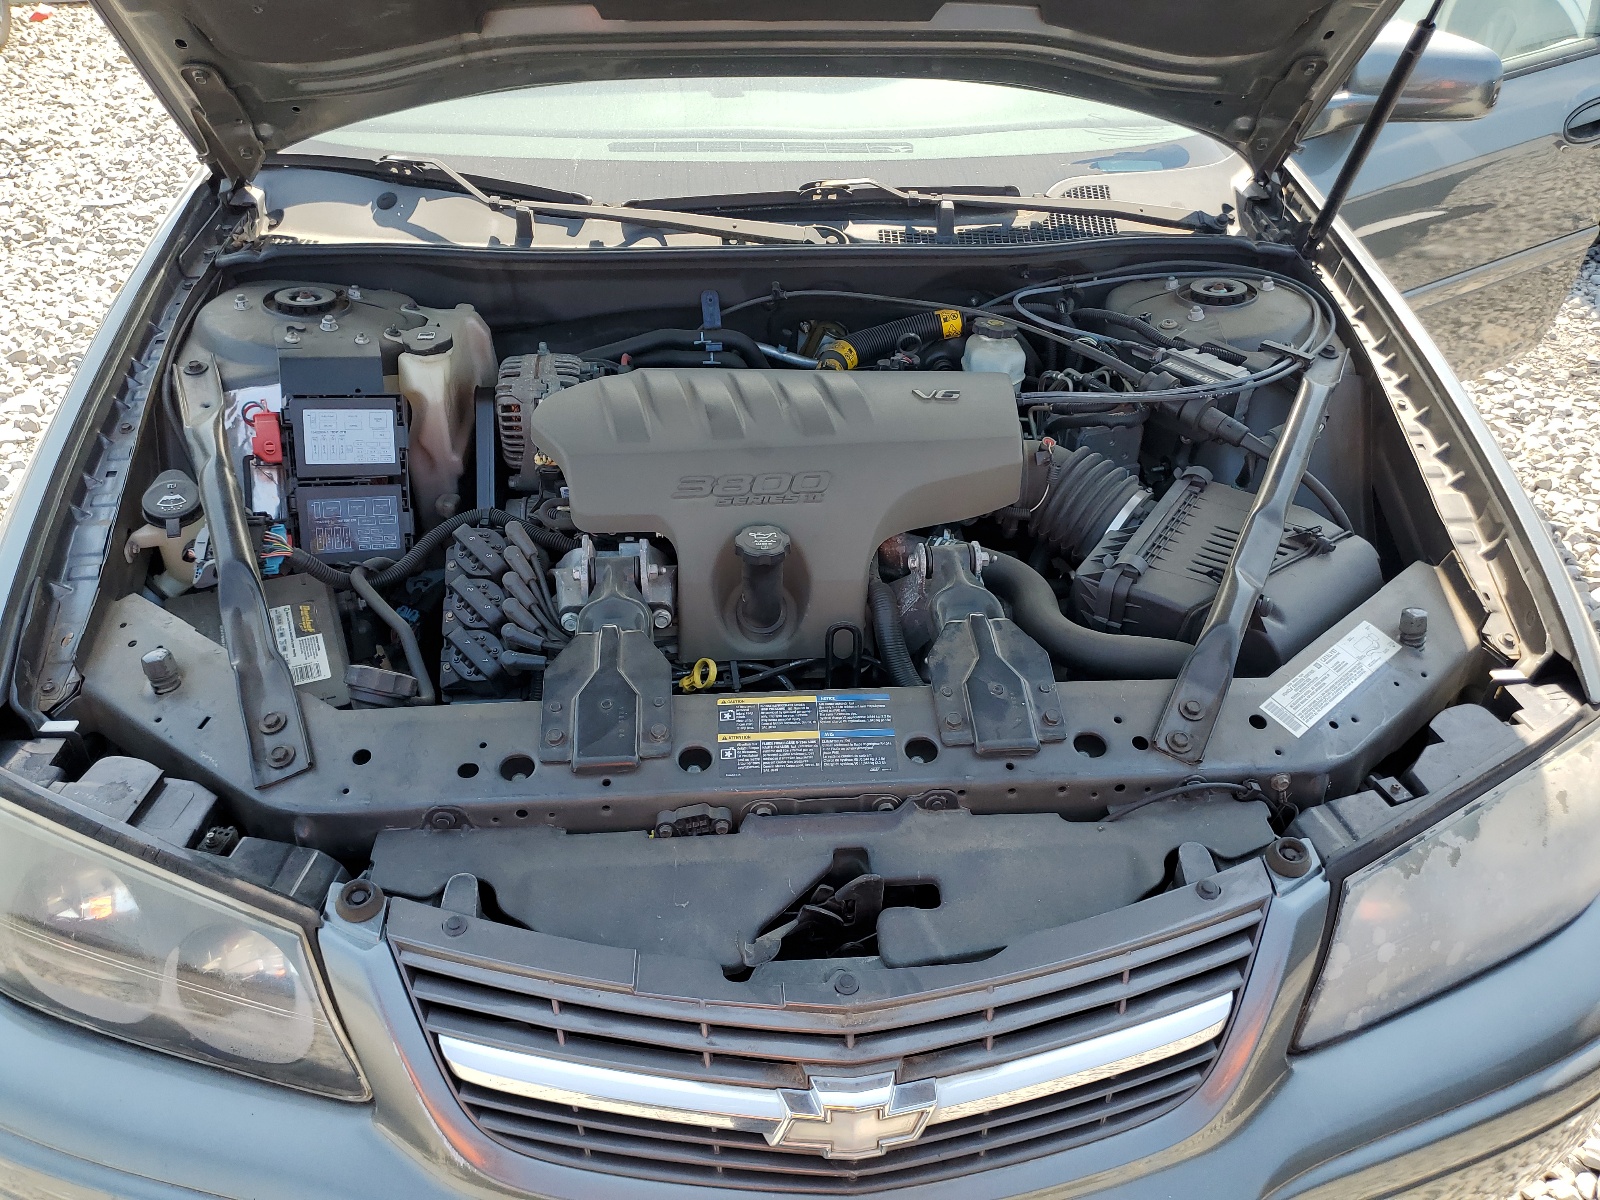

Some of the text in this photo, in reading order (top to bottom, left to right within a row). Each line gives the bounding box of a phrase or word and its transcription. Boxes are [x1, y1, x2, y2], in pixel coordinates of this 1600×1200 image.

[911, 388, 961, 402] V6
[671, 471, 832, 500] 3800
[714, 495, 800, 508] SERIES
